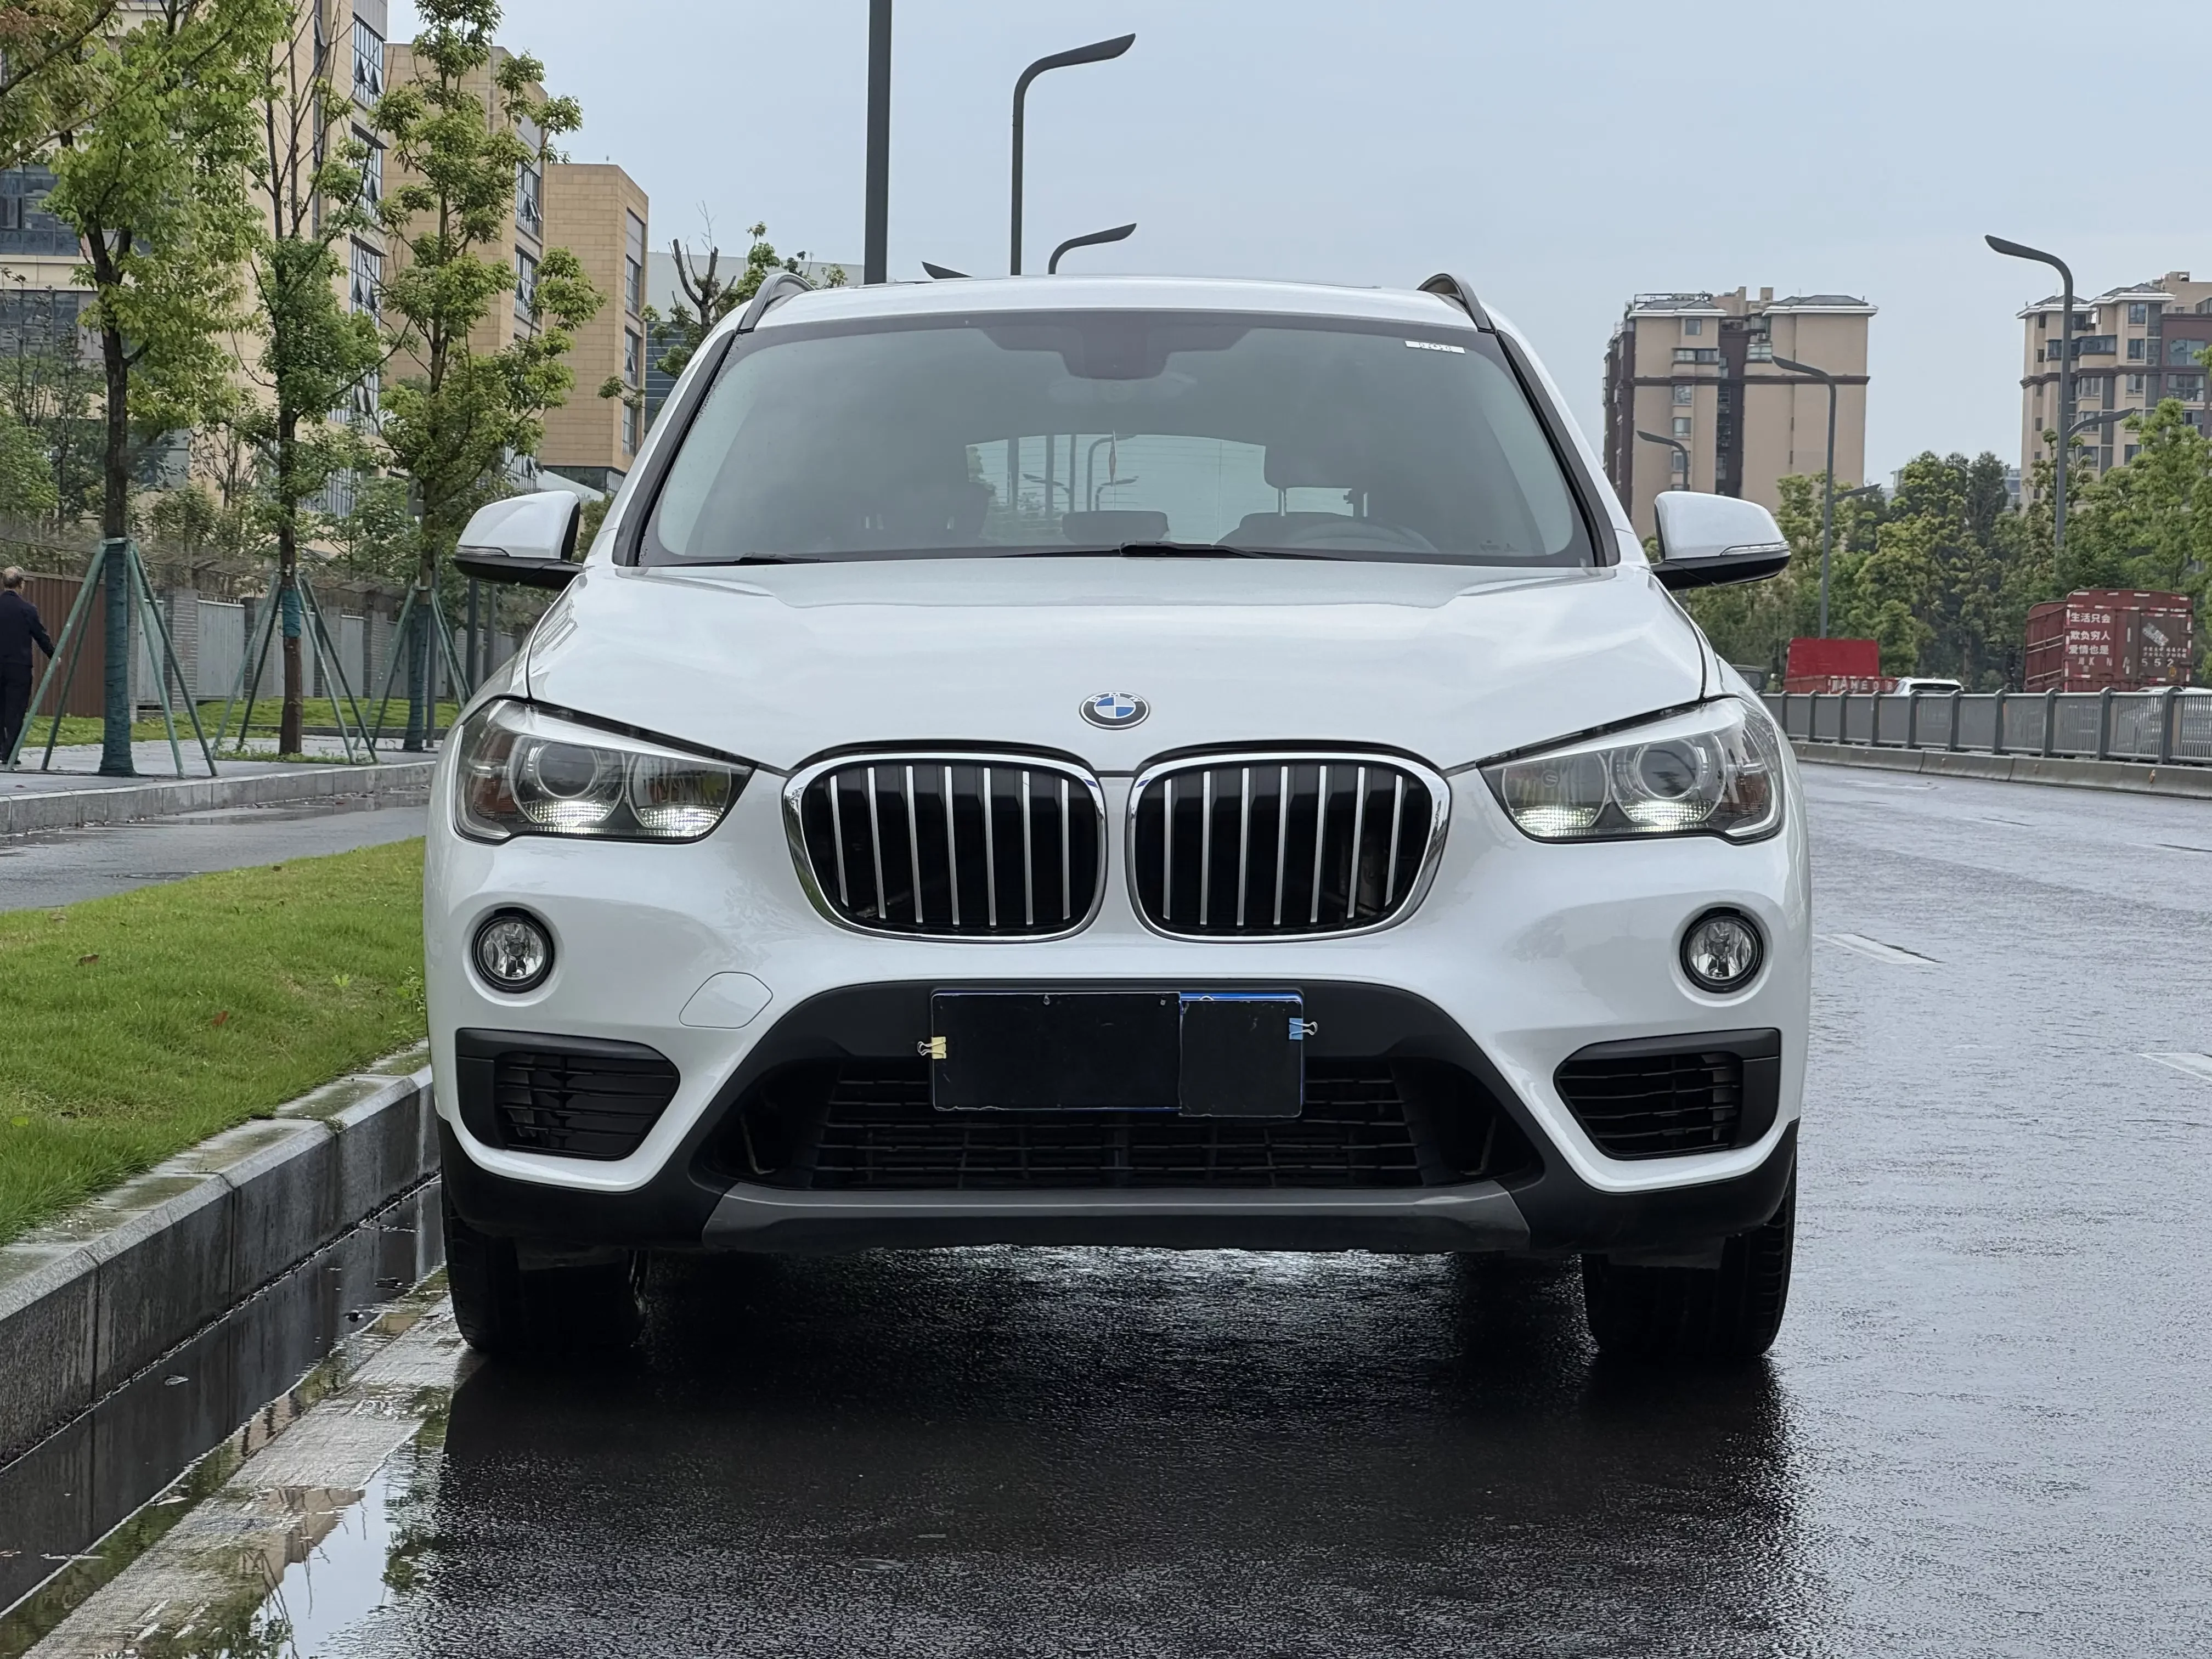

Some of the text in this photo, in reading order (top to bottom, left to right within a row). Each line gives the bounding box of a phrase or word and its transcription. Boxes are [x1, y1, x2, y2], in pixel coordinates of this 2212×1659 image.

[2070, 612, 2111, 623] 生活只会
[2070, 630, 2111, 641] 欺负穷人
[2068, 644, 2109, 655] 爱情也是
[1088, 692, 1142, 703] BMW
